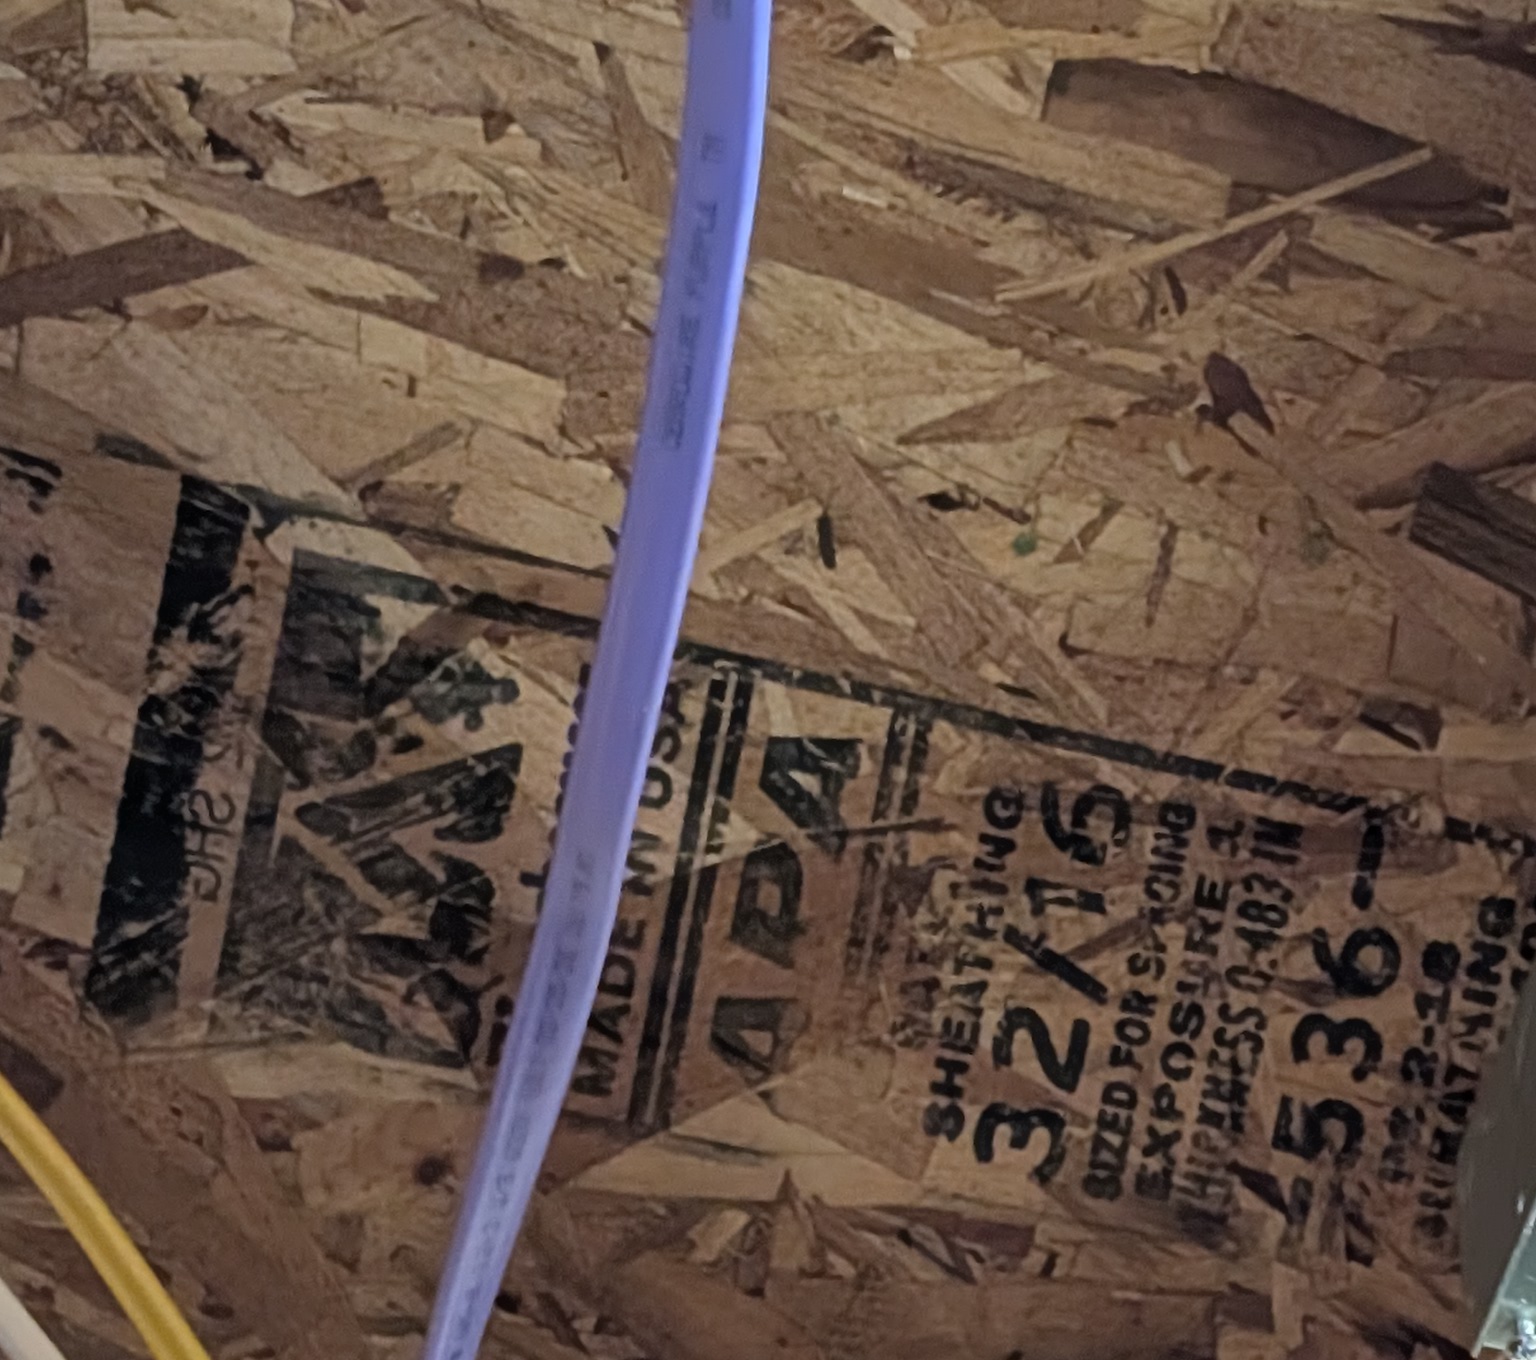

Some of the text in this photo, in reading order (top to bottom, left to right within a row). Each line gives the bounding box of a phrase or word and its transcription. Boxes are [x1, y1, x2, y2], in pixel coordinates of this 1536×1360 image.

[577, 917, 646, 1101] MADE
[708, 736, 862, 1085] APA
[922, 786, 1025, 1141] SHEATHING
[974, 784, 1126, 1180] 32/16
[1107, 988, 1157, 1072] FOR
[1138, 815, 1244, 1203] EXPOSURE 1
[1178, 816, 1303, 1228] HICKNESS 0.483 IN
[1080, 1078, 1139, 1202] SIZED
